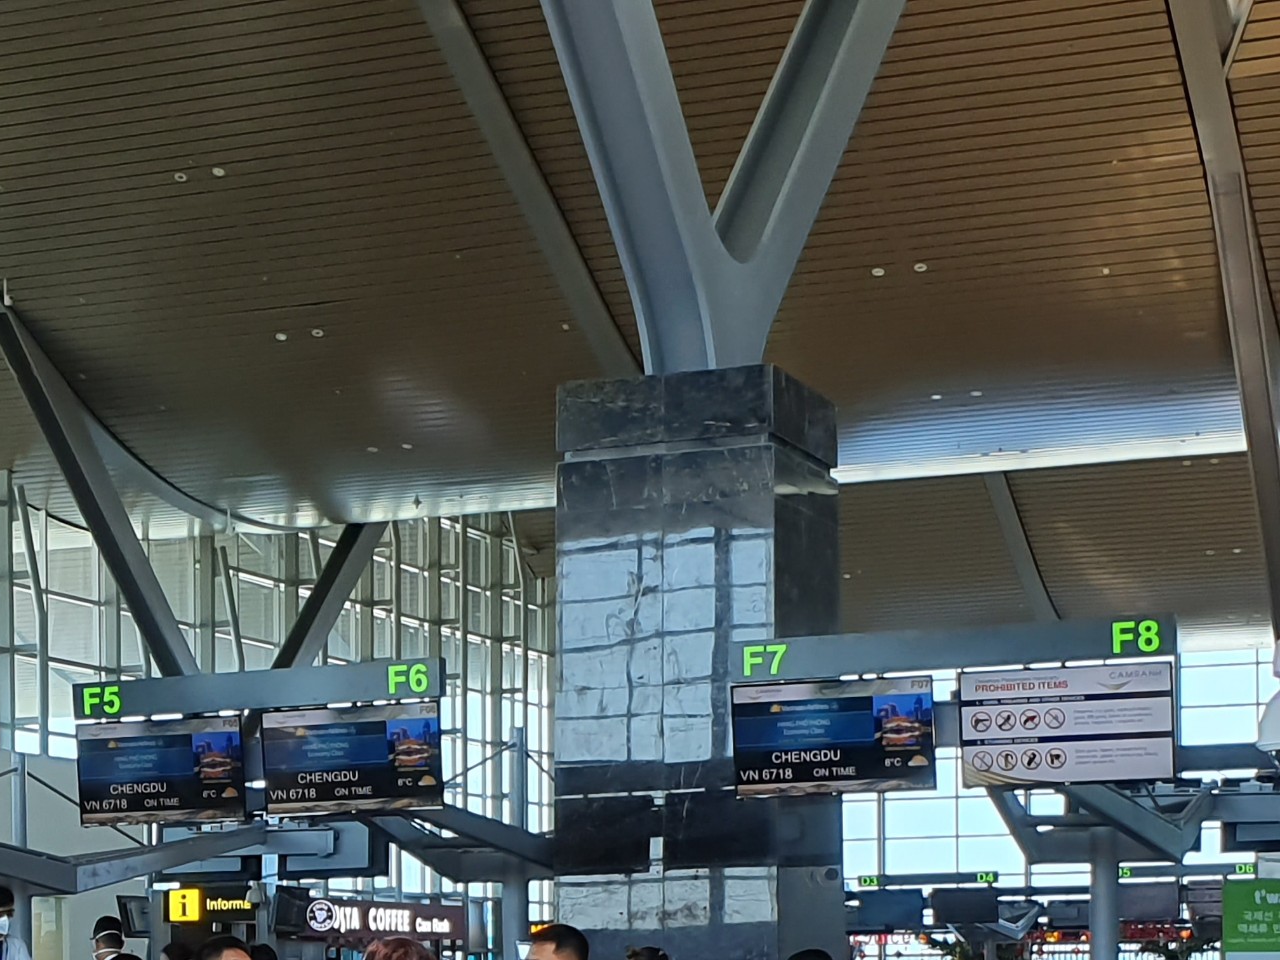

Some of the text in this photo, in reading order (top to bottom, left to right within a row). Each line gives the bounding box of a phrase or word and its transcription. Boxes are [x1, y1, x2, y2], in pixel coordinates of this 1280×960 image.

[1112, 620, 1160, 654] F8
[743, 644, 787, 677] F7
[387, 663, 429, 695] F6
[975, 682, 1035, 693] PROHIBITED
[1038, 680, 1068, 690] ITEMS
[83, 685, 121, 715] F5
[772, 750, 840, 763] CHENGDU
[297, 770, 359, 784] CHENGDU
[740, 767, 857, 781] VN 6718 ON TIME
[109, 782, 167, 795] CHENGDU
[270, 785, 373, 800] VN 6718 ON TIME
[83, 797, 180, 811] VN 6718 ON TIME
[1119, 867, 1131, 877] 5
[1235, 864, 1254, 873] D6
[861, 877, 878, 886] D3
[977, 873, 994, 882] D4
[368, 907, 410, 932] COFFEE
